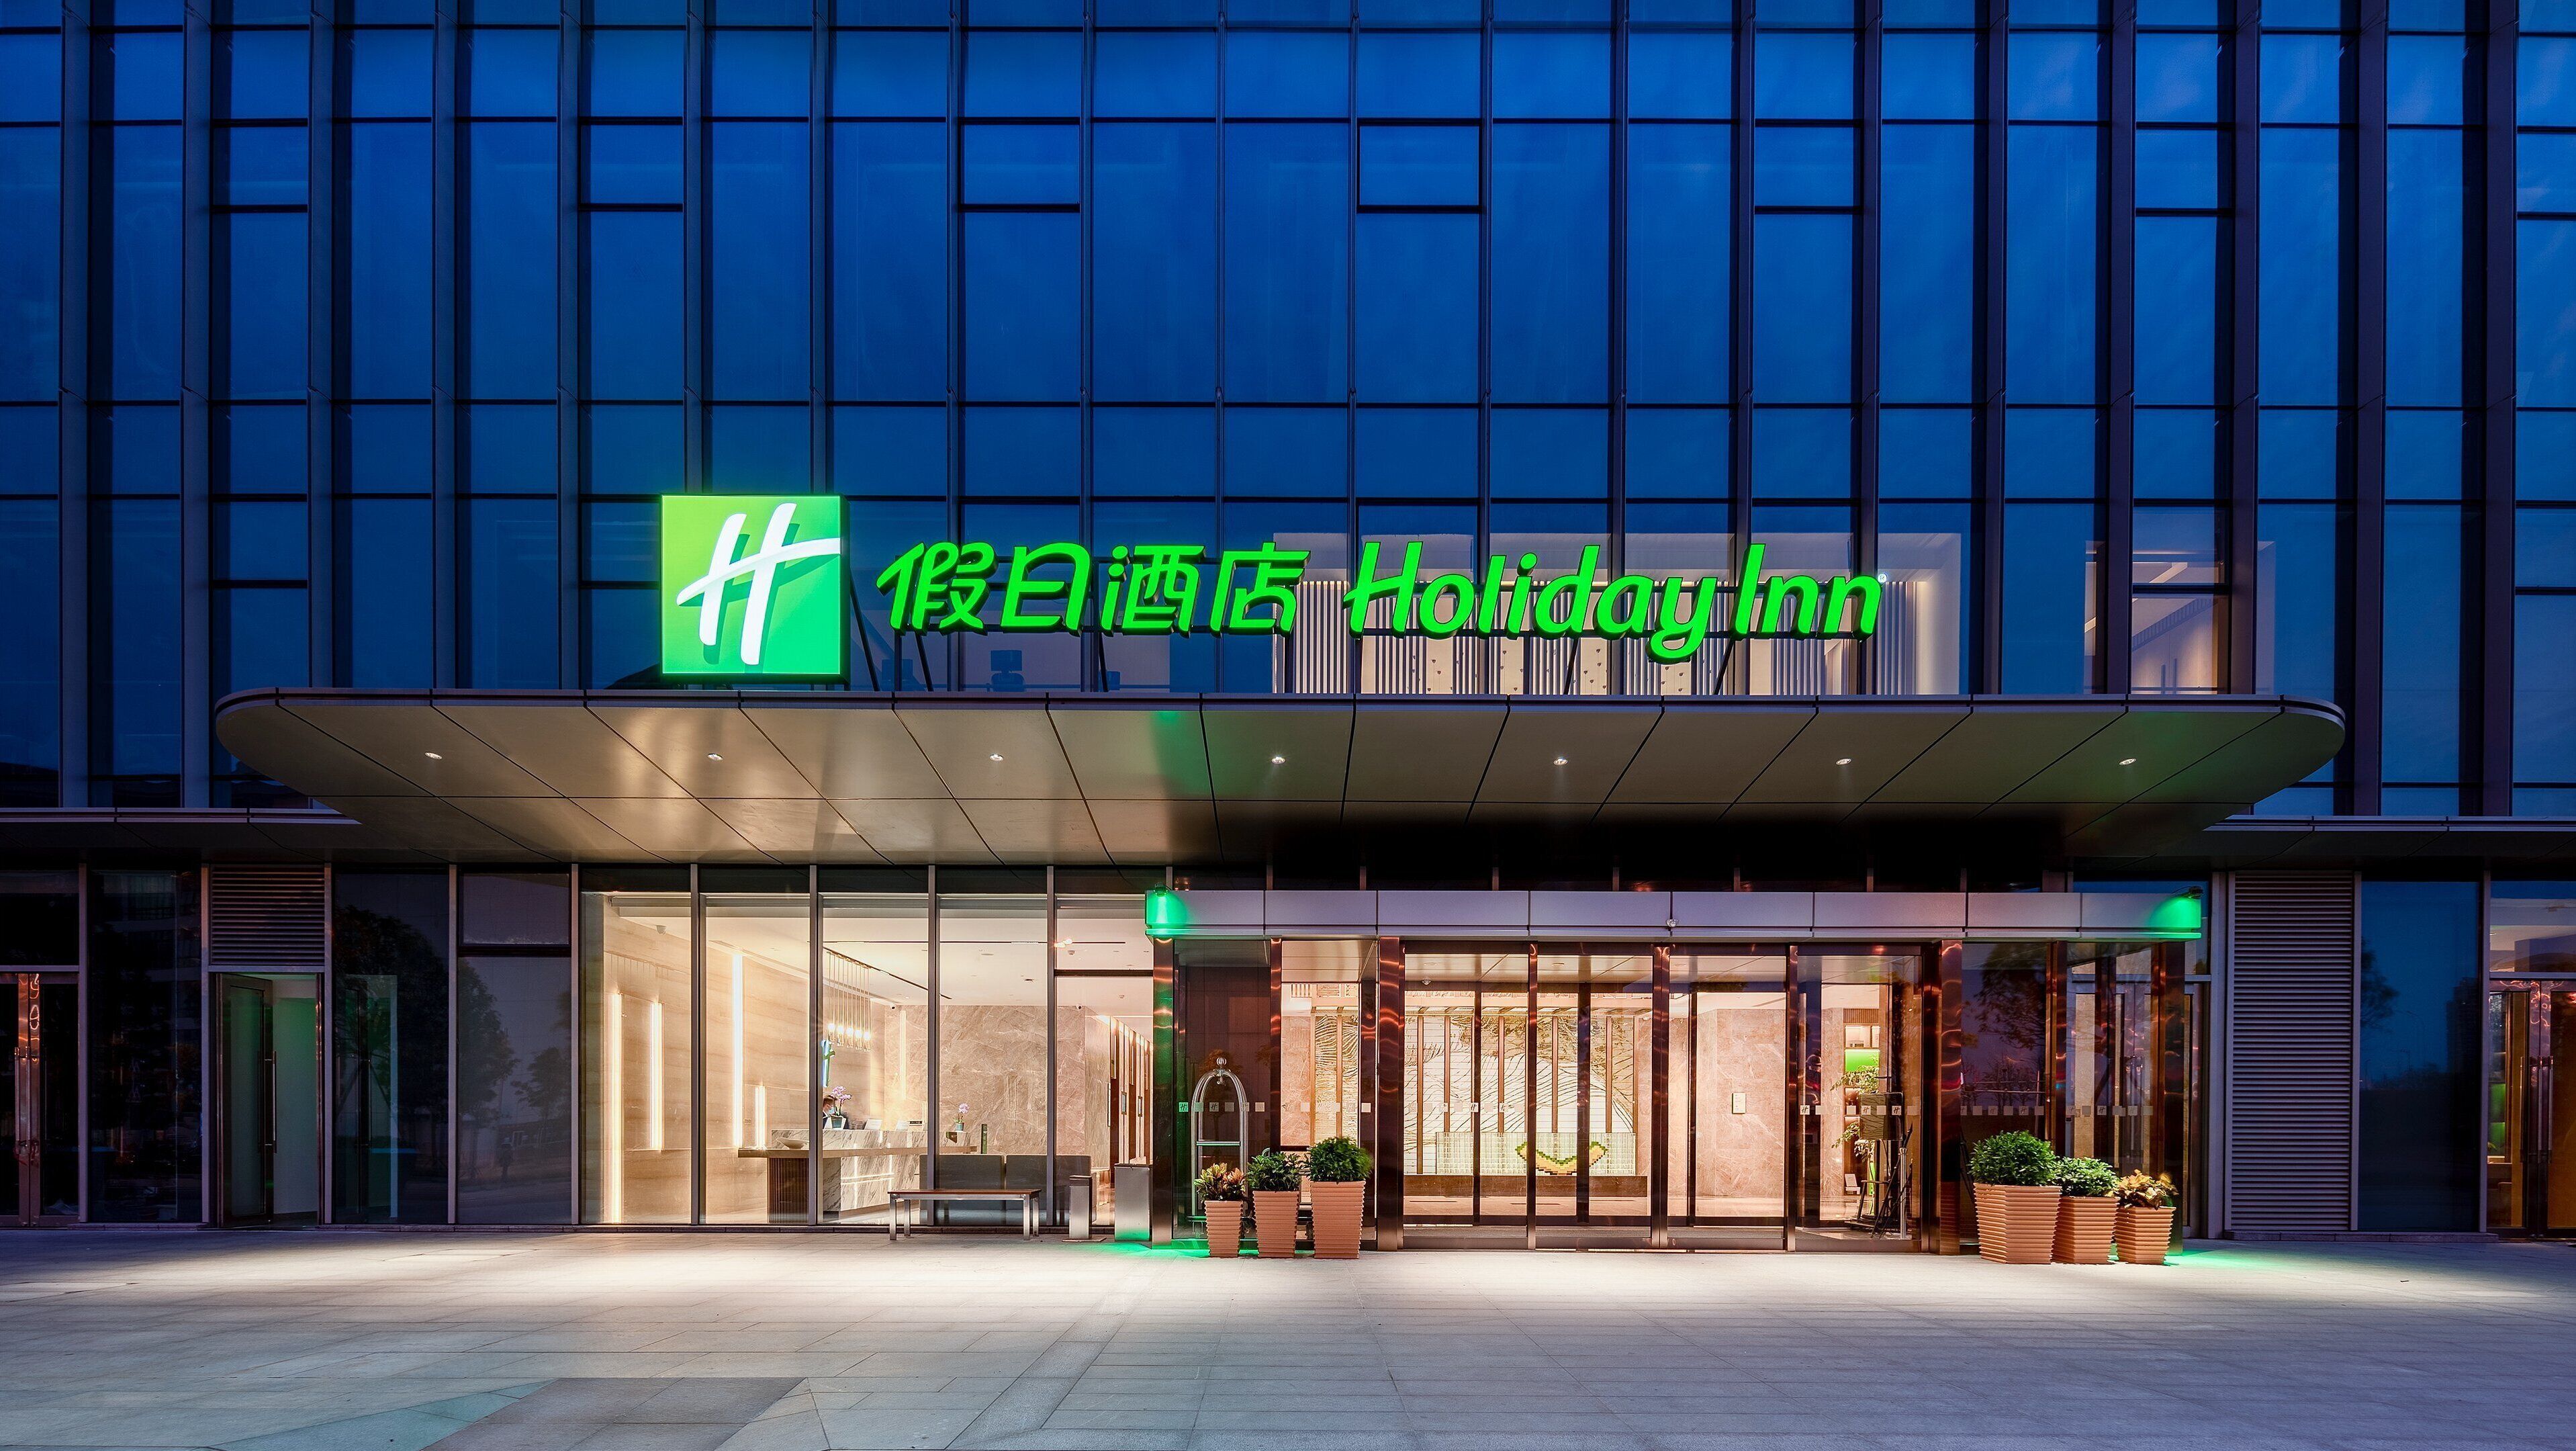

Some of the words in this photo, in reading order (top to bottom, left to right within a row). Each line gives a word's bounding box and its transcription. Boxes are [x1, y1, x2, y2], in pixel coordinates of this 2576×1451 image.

[876, 541, 1311, 635] 假日酒店
[1342, 541, 1718, 661] Holiday
[1734, 543, 1882, 637] Inn
